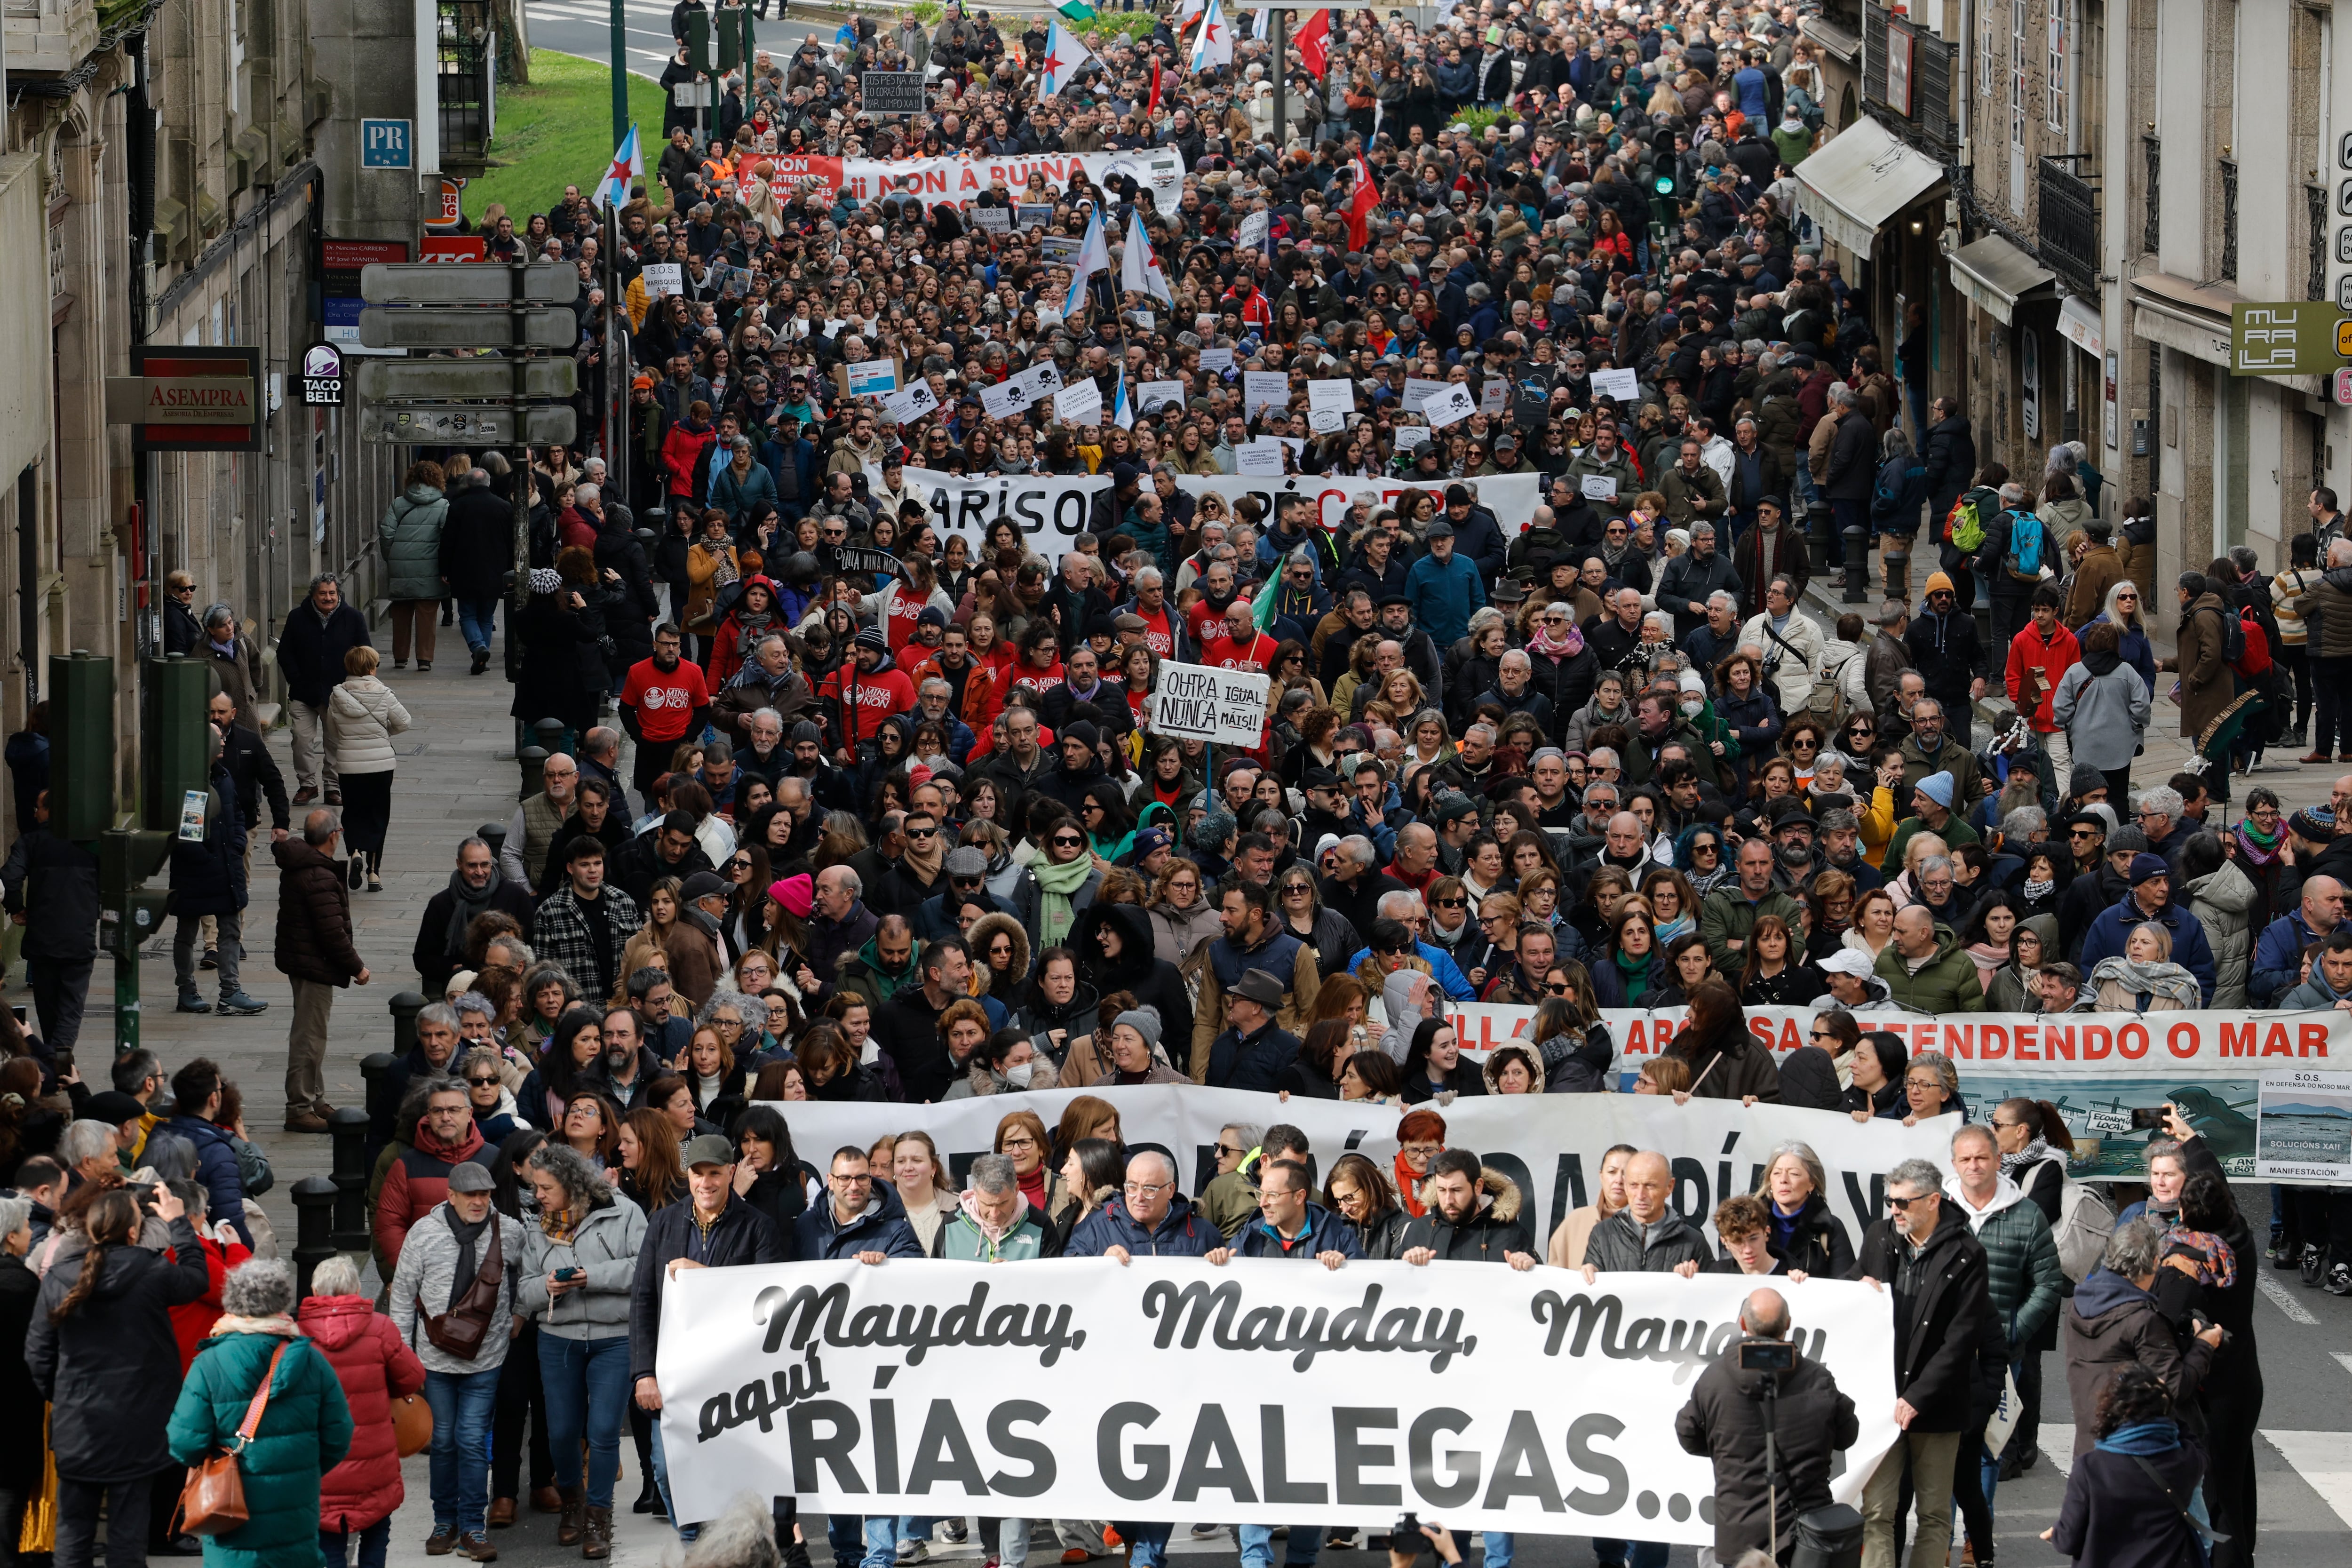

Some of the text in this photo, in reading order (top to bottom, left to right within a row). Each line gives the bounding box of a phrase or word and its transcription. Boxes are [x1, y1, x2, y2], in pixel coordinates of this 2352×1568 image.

[866, 74, 922, 85] COS PÉS NA AREA
[876, 85, 903, 97] CORAZÓN
[905, 88, 912, 96] NO
[912, 88, 922, 96] MAR
[866, 99, 879, 108] MAR
[882, 99, 902, 108] LIMPO
[369, 126, 404, 150] PR
[767, 158, 808, 172] NON
[879, 170, 945, 197] NON
[959, 160, 980, 188] Á
[990, 157, 1085, 188] RUINA
[1241, 224, 1268, 239] MARISQUEO
[650, 266, 676, 275] S.O.S.
[343, 329, 358, 338] HU
[303, 380, 341, 391] TACO
[149, 385, 248, 406] ASEMPRA
[306, 391, 341, 403] BELL
[1065, 388, 1088, 401] MENUDO
[1489, 388, 1500, 397] SOS
[1062, 394, 1086, 408] EJEMPLO
[1063, 394, 1098, 414] ESTÁIS DANDO
[896, 407, 910, 415] MEAZADO
[864, 554, 881, 571] MINA
[883, 556, 898, 575] NON
[1148, 633, 1170, 643] MINA
[1147, 643, 1170, 653] NON
[666, 689, 689, 697] MINA
[865, 687, 890, 698] MINA
[1225, 686, 1262, 705] IGUAL
[665, 698, 689, 708] NON
[862, 697, 890, 708] NON
[1160, 697, 1217, 729] NUNCA
[2167, 1022, 2201, 1059] O
[2219, 1022, 2328, 1058] MAR
[2295, 1074, 2321, 1082] S.O.S.
[2097, 1121, 2125, 1131] LOCAL
[2270, 1140, 2320, 1150] SOLUCIÓNS
[2270, 1166, 2339, 1177] MANIFESTACIÓN!
[754, 1280, 1477, 1374] Mayday, Mayday,
[697, 1341, 830, 1443] aquí
[786, 1365, 1057, 1498] RÍAS
